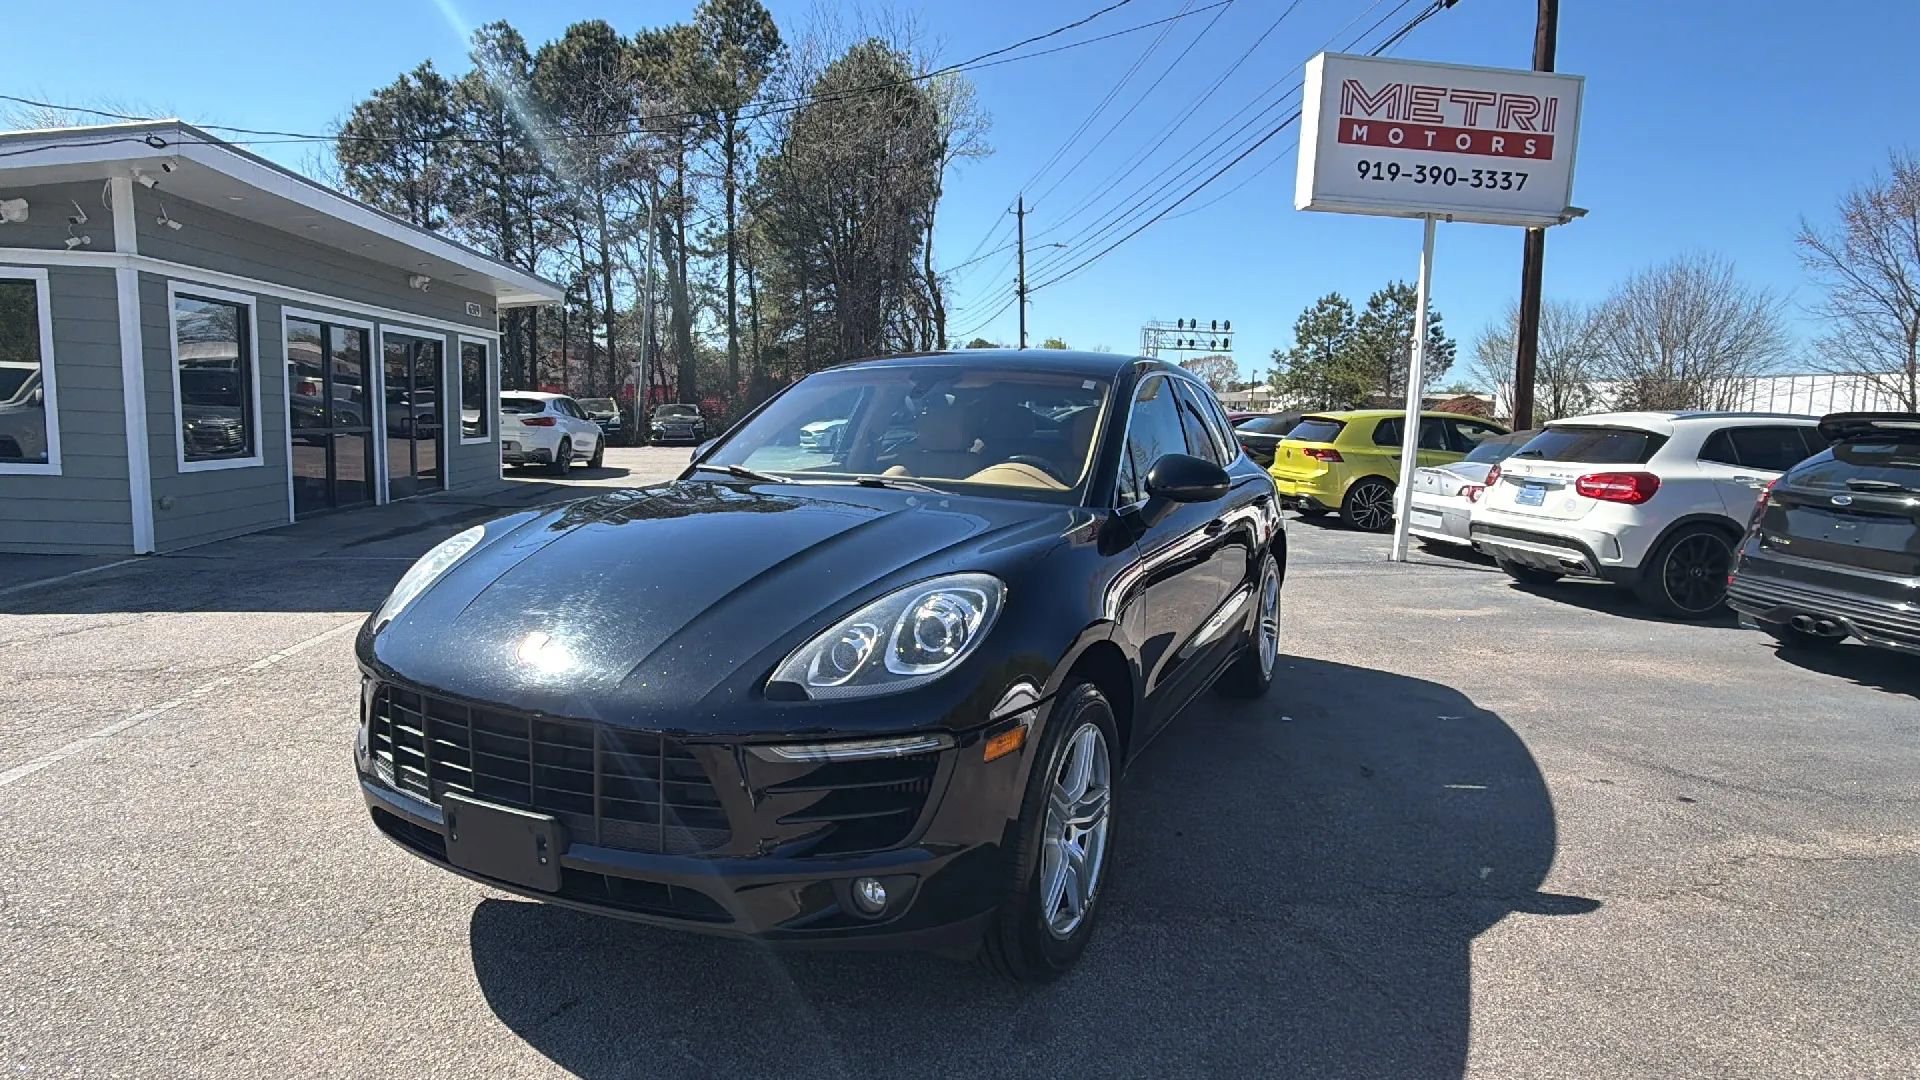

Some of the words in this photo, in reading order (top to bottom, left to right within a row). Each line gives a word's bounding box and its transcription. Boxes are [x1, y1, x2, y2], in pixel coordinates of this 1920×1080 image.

[1340, 79, 1558, 132] METRI
[1351, 124, 1537, 155] MOTORS
[1357, 160, 1529, 191] 919-390-3337
